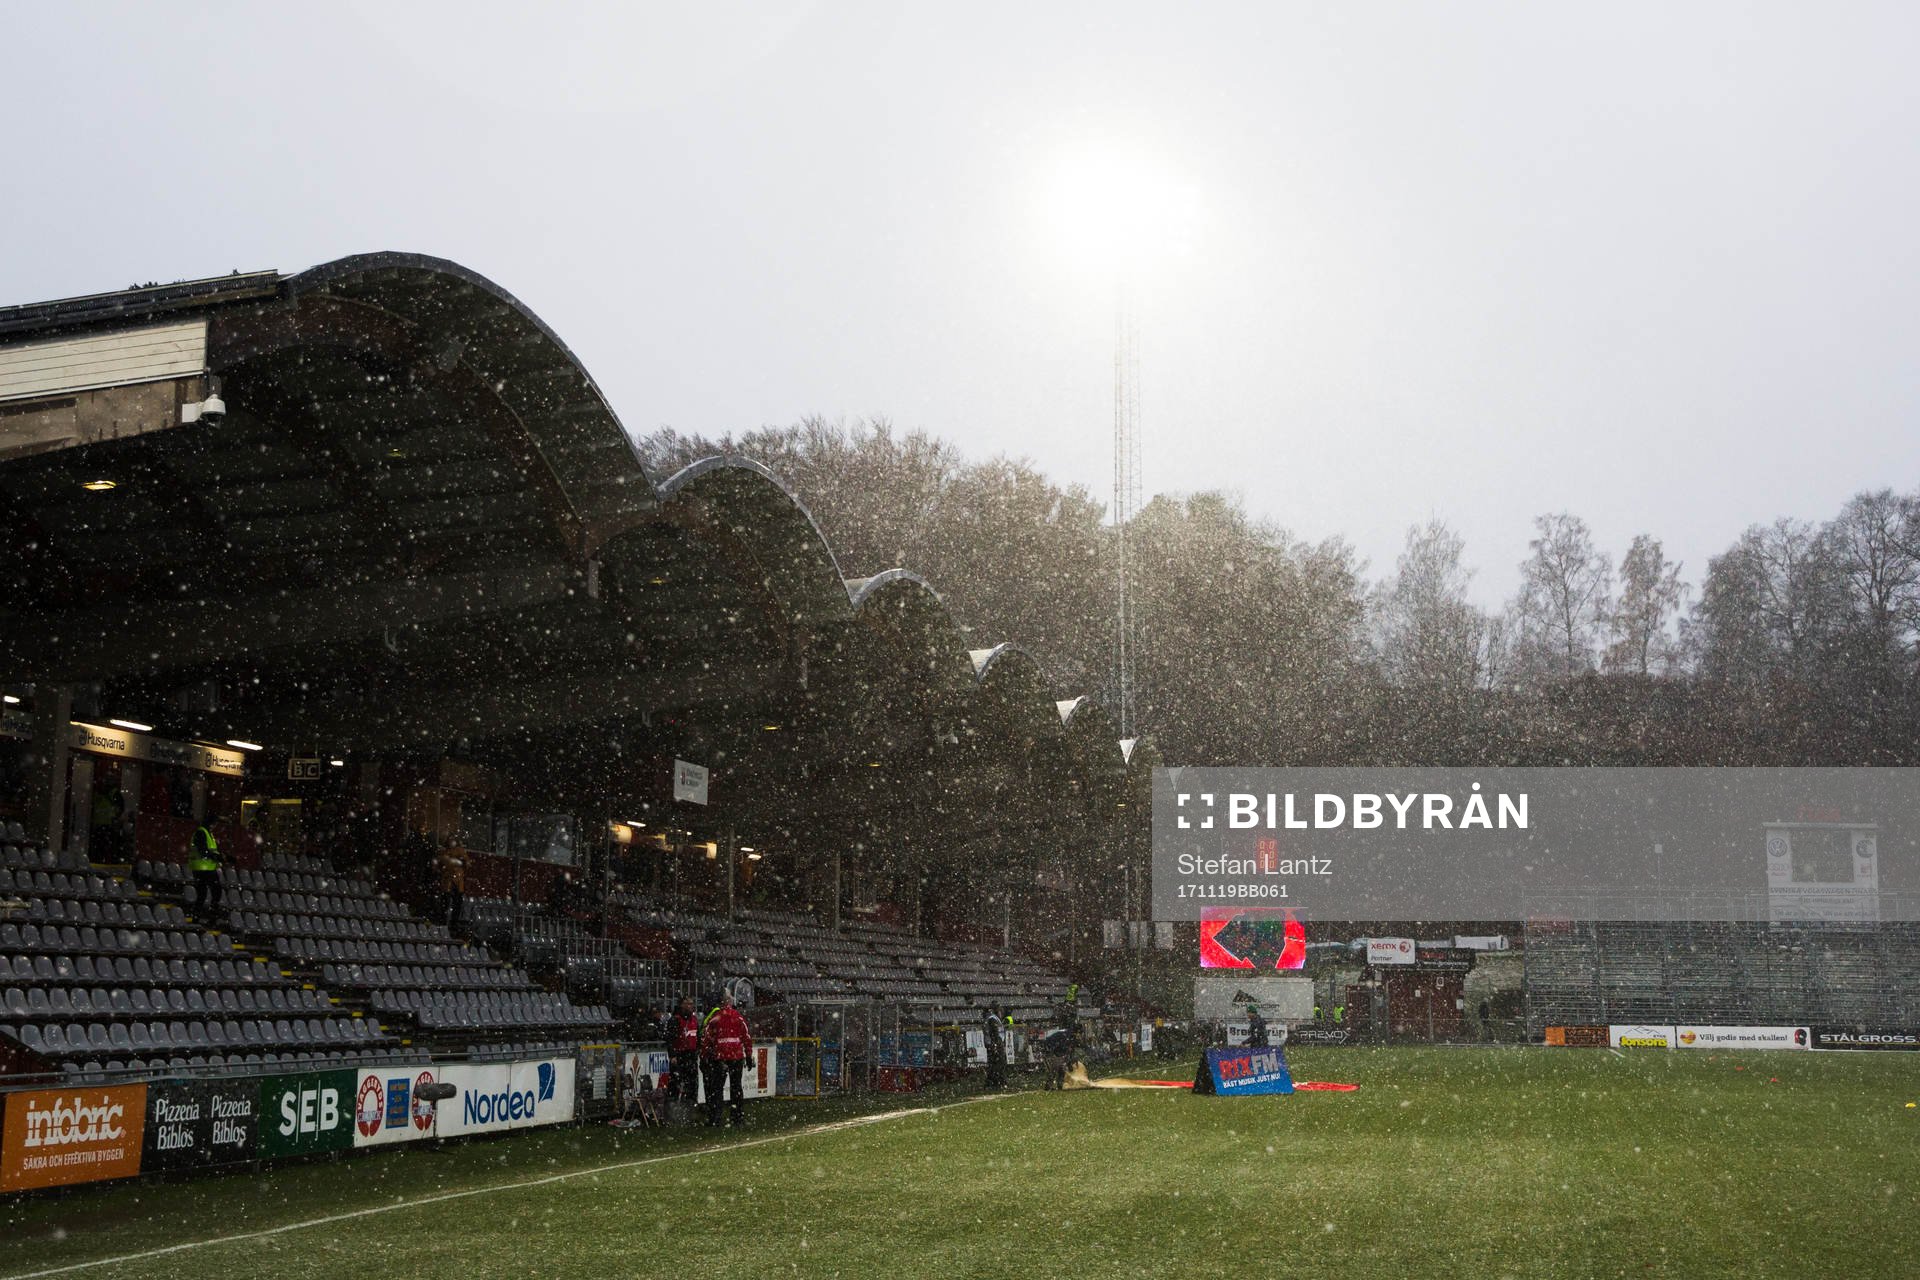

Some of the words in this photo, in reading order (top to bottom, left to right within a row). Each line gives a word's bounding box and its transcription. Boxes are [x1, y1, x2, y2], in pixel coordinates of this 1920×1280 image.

[87, 732, 125, 750] Husqvarna
[1371, 942, 1397, 950] xerox
[1700, 1033, 1714, 1042] Välj
[1716, 1033, 1737, 1042] godis
[1739, 1033, 1756, 1041] med
[1820, 1033, 1916, 1042] STÅLGROSS
[1256, 1074, 1270, 1083] JUST
[155, 1098, 200, 1123] Pizzeria
[210, 1095, 252, 1119] Pizzeria
[279, 1087, 340, 1137] SEB
[464, 1083, 535, 1126] Nordea
[24, 1096, 124, 1147] infobric
[212, 1120, 248, 1145] Biblos
[157, 1123, 194, 1150] Biblos
[24, 1155, 48, 1170] SÄKRA
[48, 1154, 64, 1168] OCH
[63, 1150, 97, 1166] EFFEKTIVA
[97, 1148, 125, 1162] BYGGEN
